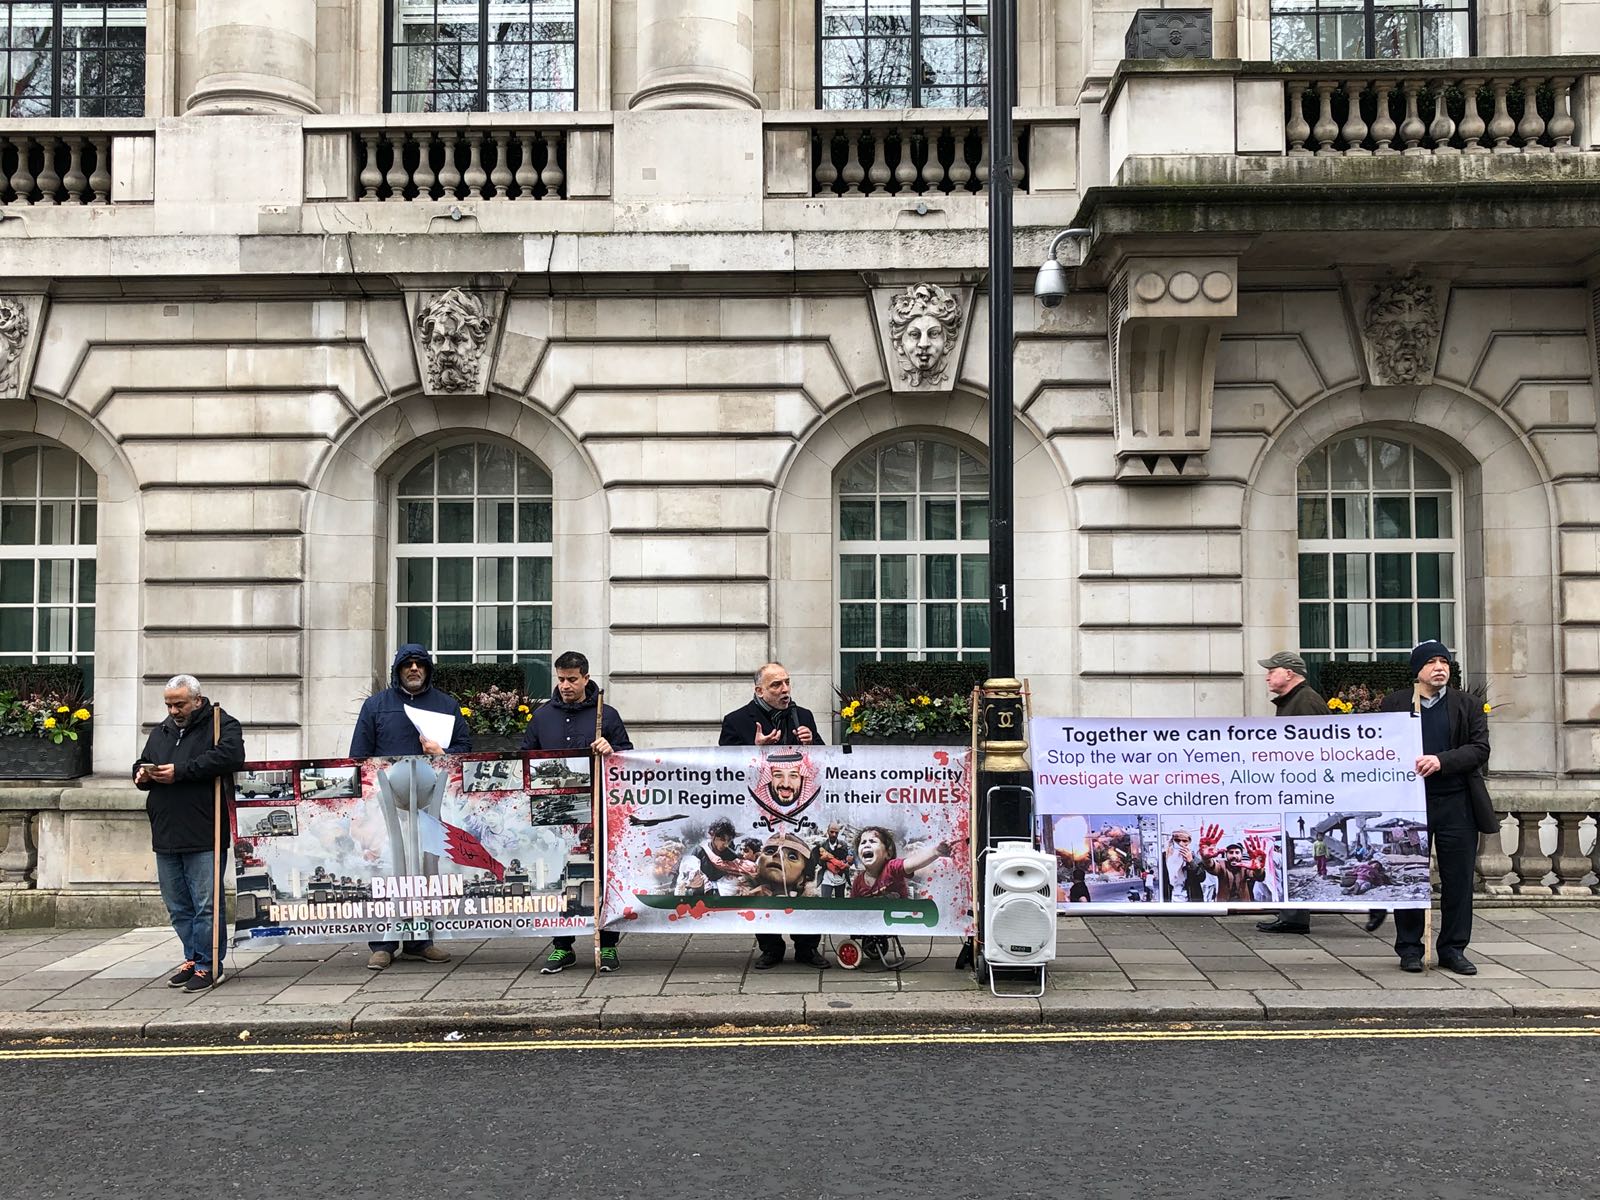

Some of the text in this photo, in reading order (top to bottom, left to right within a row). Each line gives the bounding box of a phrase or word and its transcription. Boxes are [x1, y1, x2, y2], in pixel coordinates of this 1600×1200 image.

[1062, 724, 1383, 746] Together we can force Saudis to:
[1047, 747, 1401, 767] Stop the war on Yemen, remove blockade,
[609, 766, 745, 785] Supporting the
[825, 766, 962, 783] Means complicity
[1037, 767, 1417, 788] Investigate war crimes, Allow food & medicine
[609, 789, 745, 808] SAUDI Regime
[825, 787, 961, 804] in their CRIMES
[1116, 790, 1335, 806] Save children from famine
[371, 873, 464, 899] BAHRAIN
[269, 894, 568, 922] REVOLUTION FOR LIBERTY & LIBERATION
[288, 922, 373, 936] ANNIVERSARY
[376, 922, 392, 932] OF
[395, 921, 432, 932] SAUDI
[435, 918, 512, 931] OCCUPATION
[515, 918, 532, 929] OF
[534, 917, 587, 928] BAHRAIN
